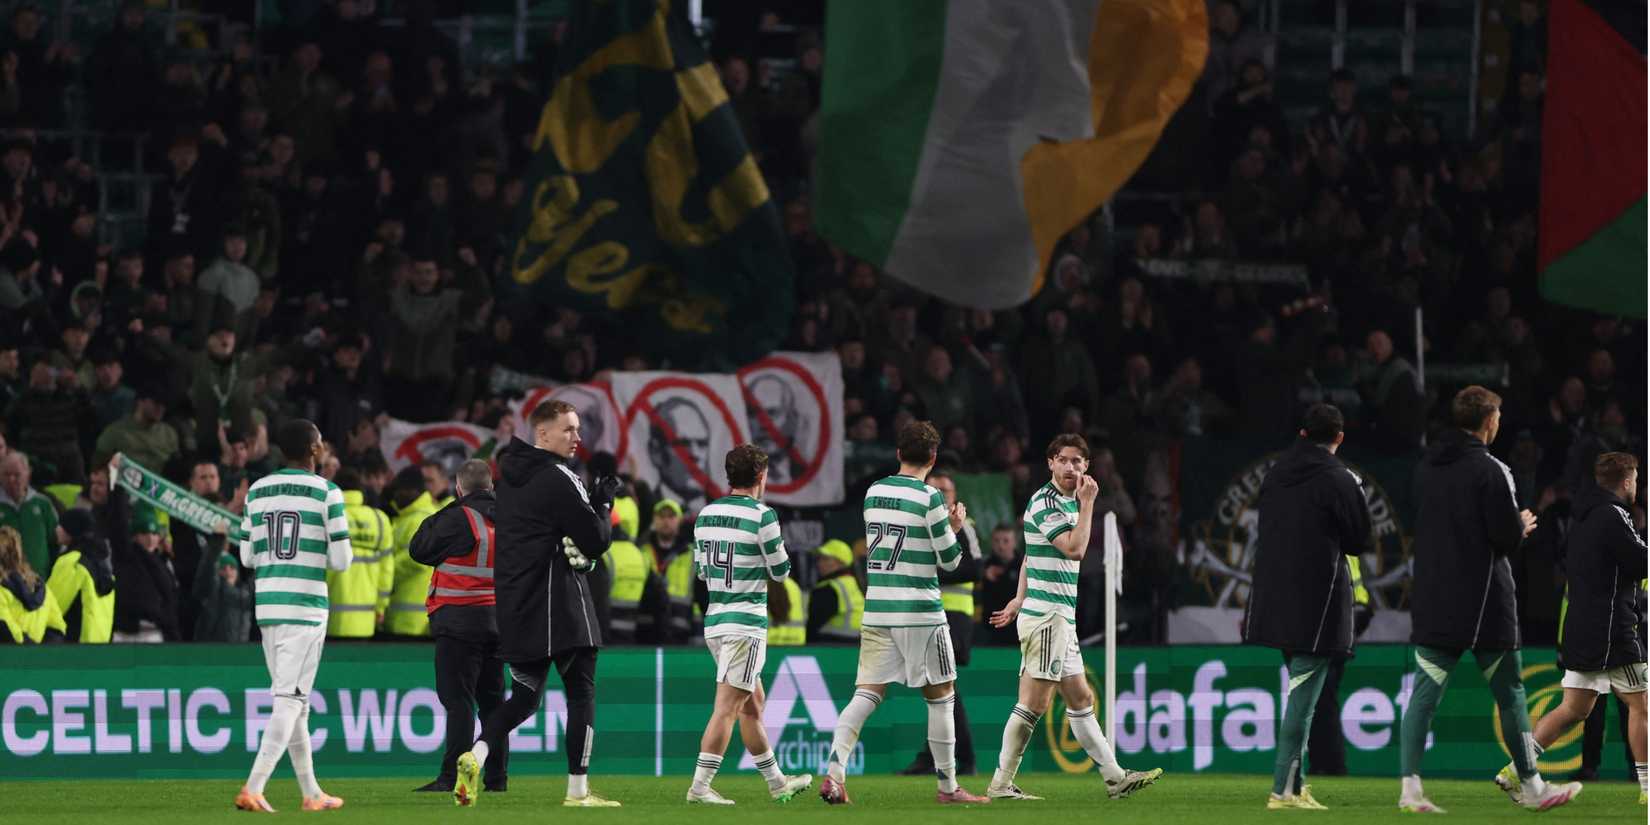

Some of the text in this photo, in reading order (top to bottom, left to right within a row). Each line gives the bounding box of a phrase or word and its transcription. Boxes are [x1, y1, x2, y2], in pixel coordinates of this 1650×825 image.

[872, 496, 901, 510] ENGELS
[1217, 458, 1277, 525] GREE
[264, 511, 300, 560] 10
[867, 522, 906, 570] 27
[703, 540, 735, 588] 14
[1, 687, 232, 754] CELTIC
[1115, 659, 1434, 772] dafae
